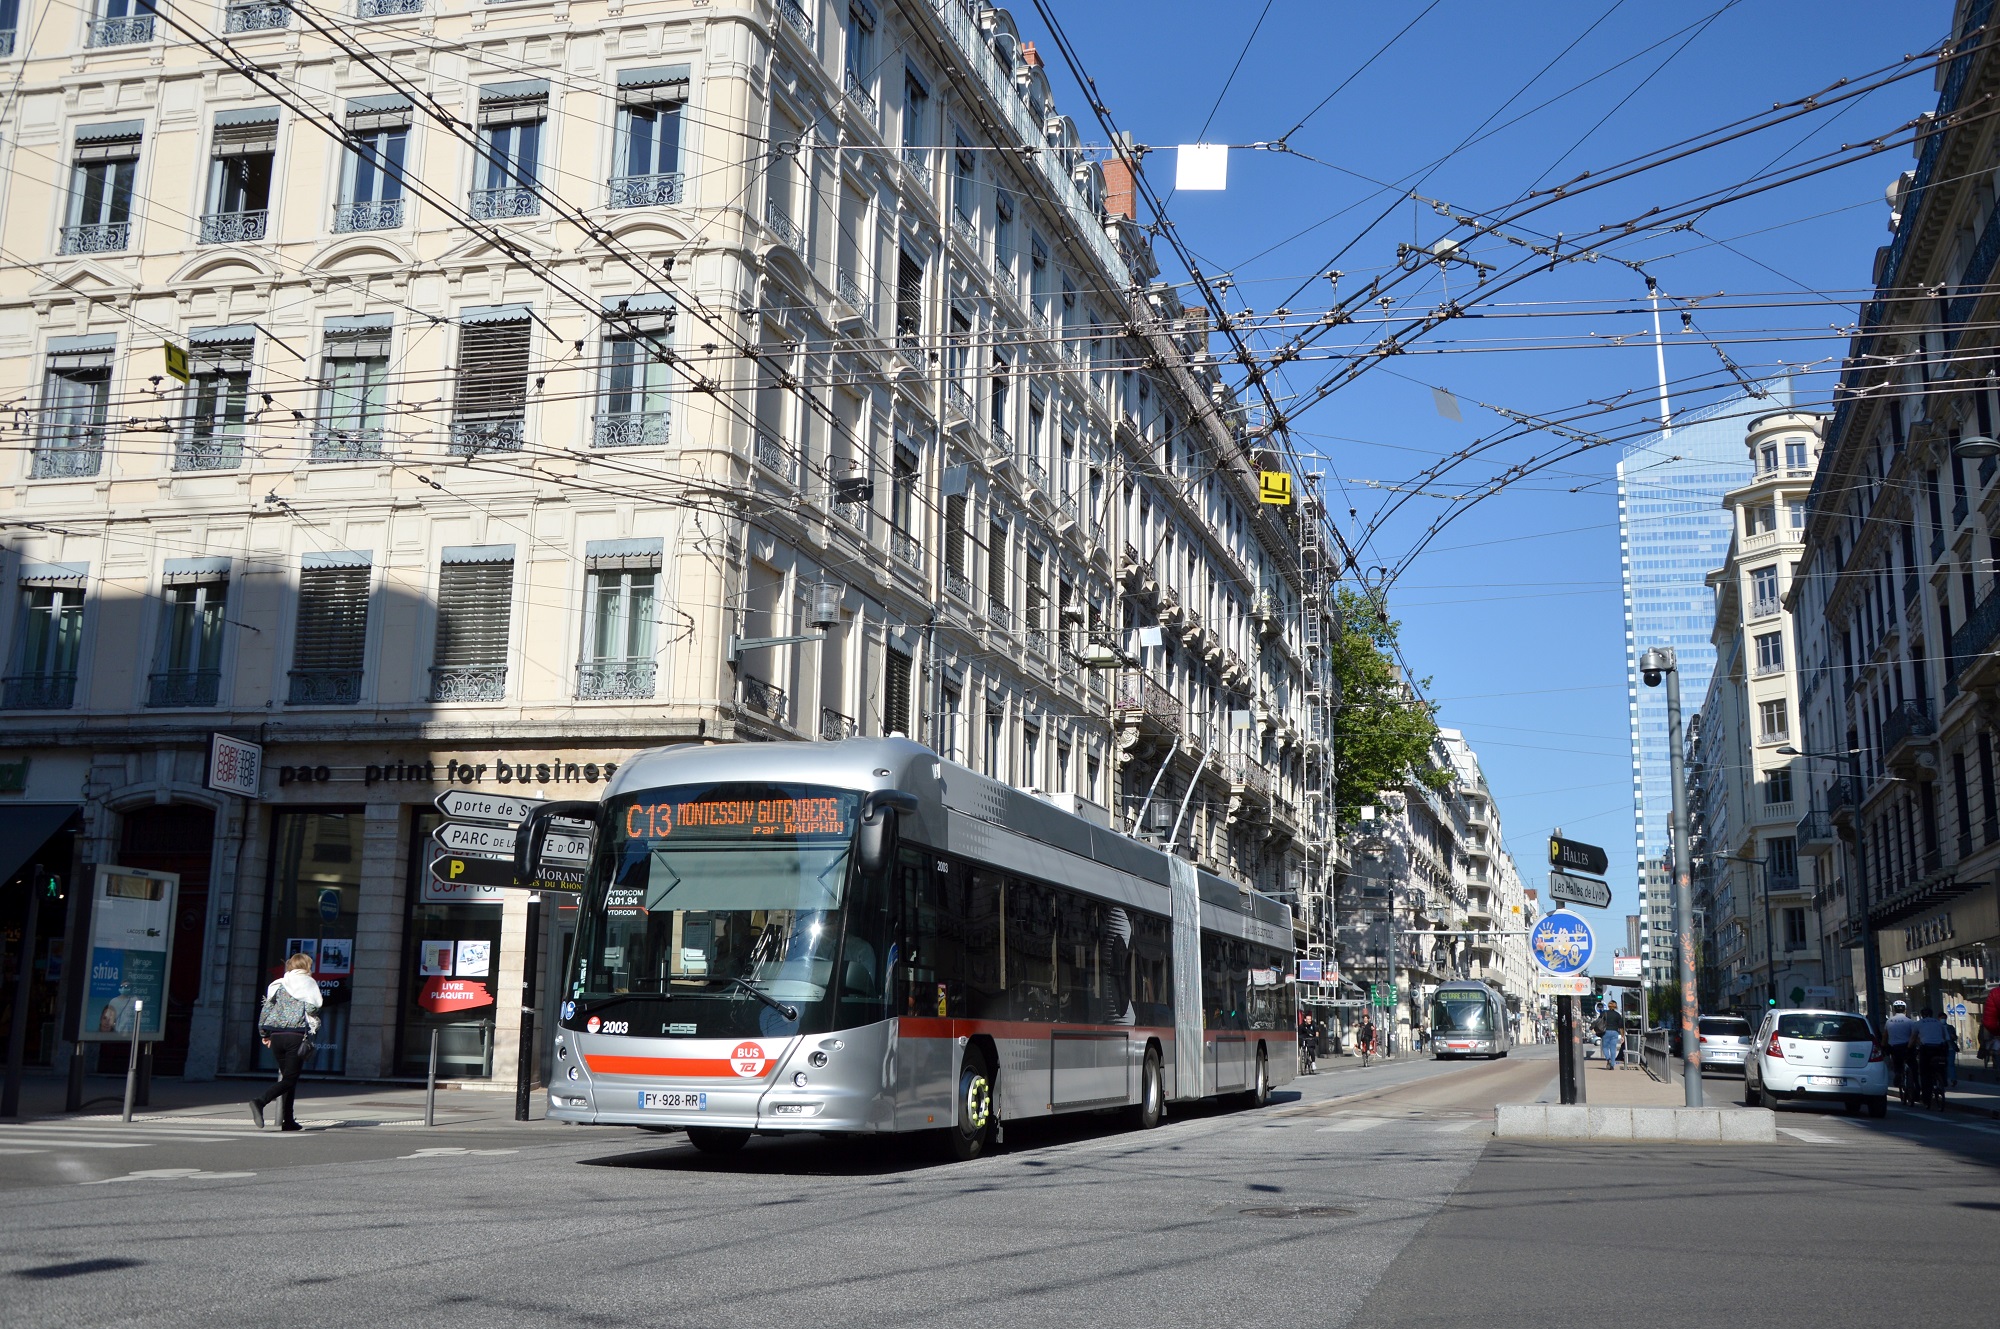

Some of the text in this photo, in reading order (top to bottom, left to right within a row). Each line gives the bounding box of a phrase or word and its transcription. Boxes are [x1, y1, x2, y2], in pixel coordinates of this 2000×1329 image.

[279, 757, 617, 787] pao print for busines
[454, 800, 492, 814] porte
[498, 802, 513, 816] de
[626, 797, 838, 838] C13 MONTESSUY GUTENBERG
[752, 820, 845, 835] par DAUPHIN
[452, 830, 489, 846] PARC
[493, 838, 504, 848] DE
[1551, 840, 1559, 860] P
[1562, 845, 1589, 866] HALLES
[449, 859, 465, 879] P
[560, 880, 582, 890] RHÔN
[1554, 878, 1565, 893] Les
[608, 889, 644, 897] PYTOP.COM
[608, 897, 638, 905] 3.01.94
[93, 960, 119, 980] shiva
[442, 982, 464, 991] LIVRE
[431, 991, 475, 1000] PLAQUETTE
[602, 1020, 629, 1034] 2003
[661, 1022, 698, 1035] HESS
[737, 1048, 760, 1058] BUS
[645, 1093, 698, 1108] FY-928-RR
